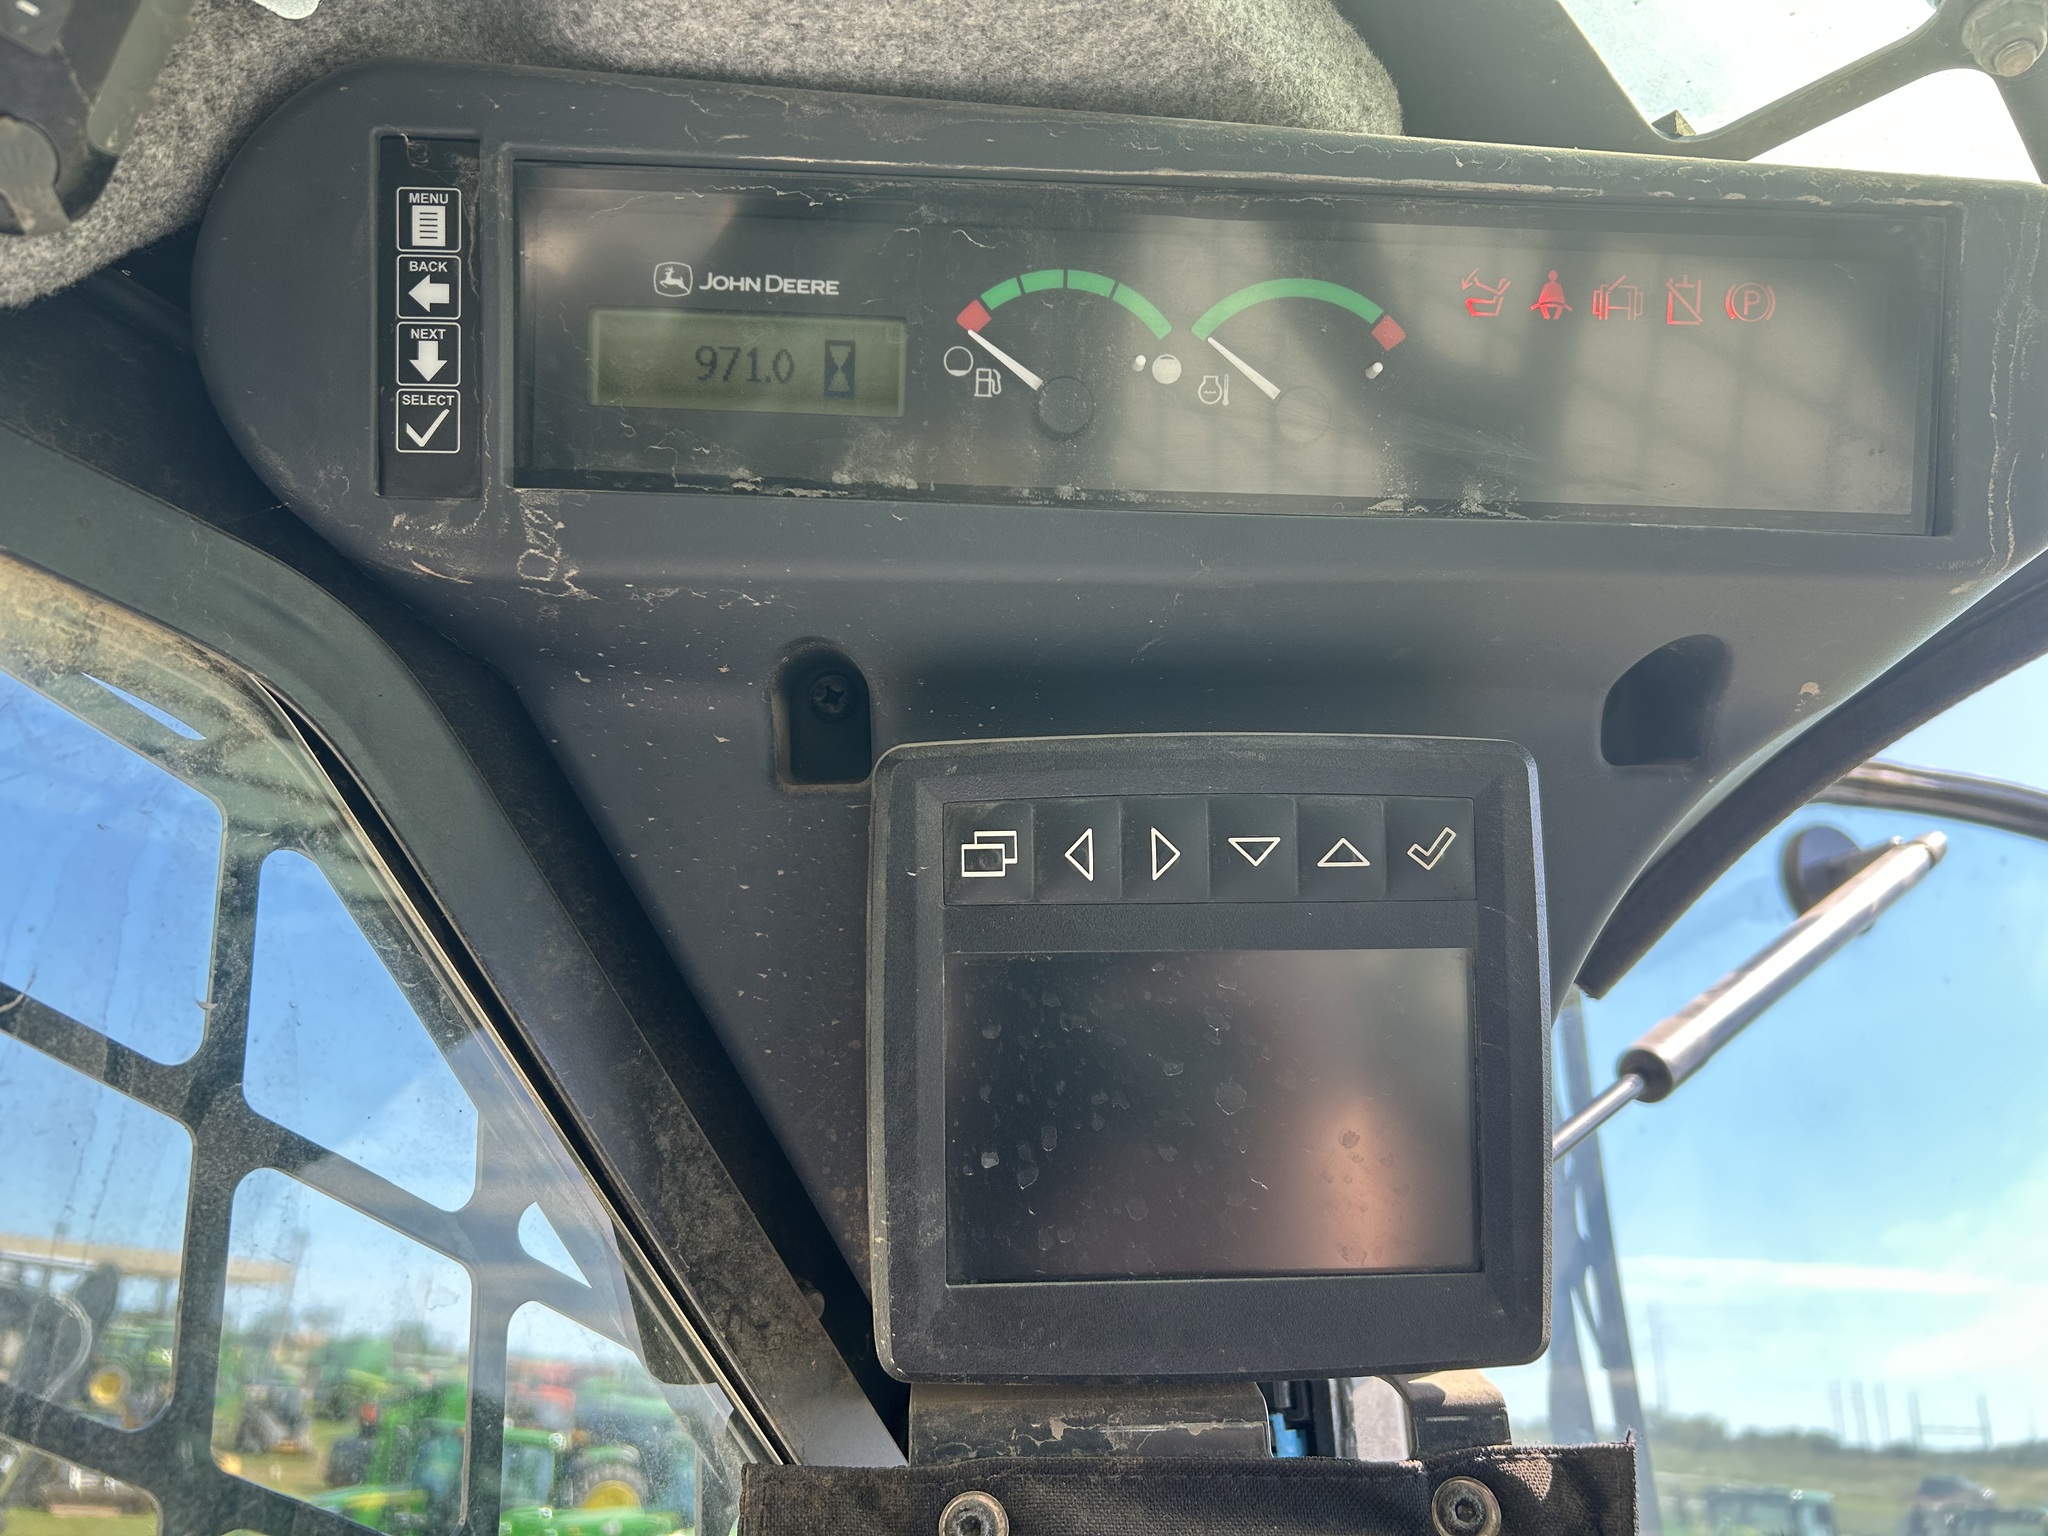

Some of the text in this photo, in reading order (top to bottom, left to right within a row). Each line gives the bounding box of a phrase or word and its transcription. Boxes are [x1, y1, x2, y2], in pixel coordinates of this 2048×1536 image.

[409, 192, 449, 204] MENU
[409, 261, 448, 272] BACK
[699, 272, 839, 295] JOHN DEERE
[1743, 290, 1761, 315] P
[411, 328, 446, 340] NEXT
[695, 345, 795, 384] 971.0
[402, 394, 455, 406] SELECT
